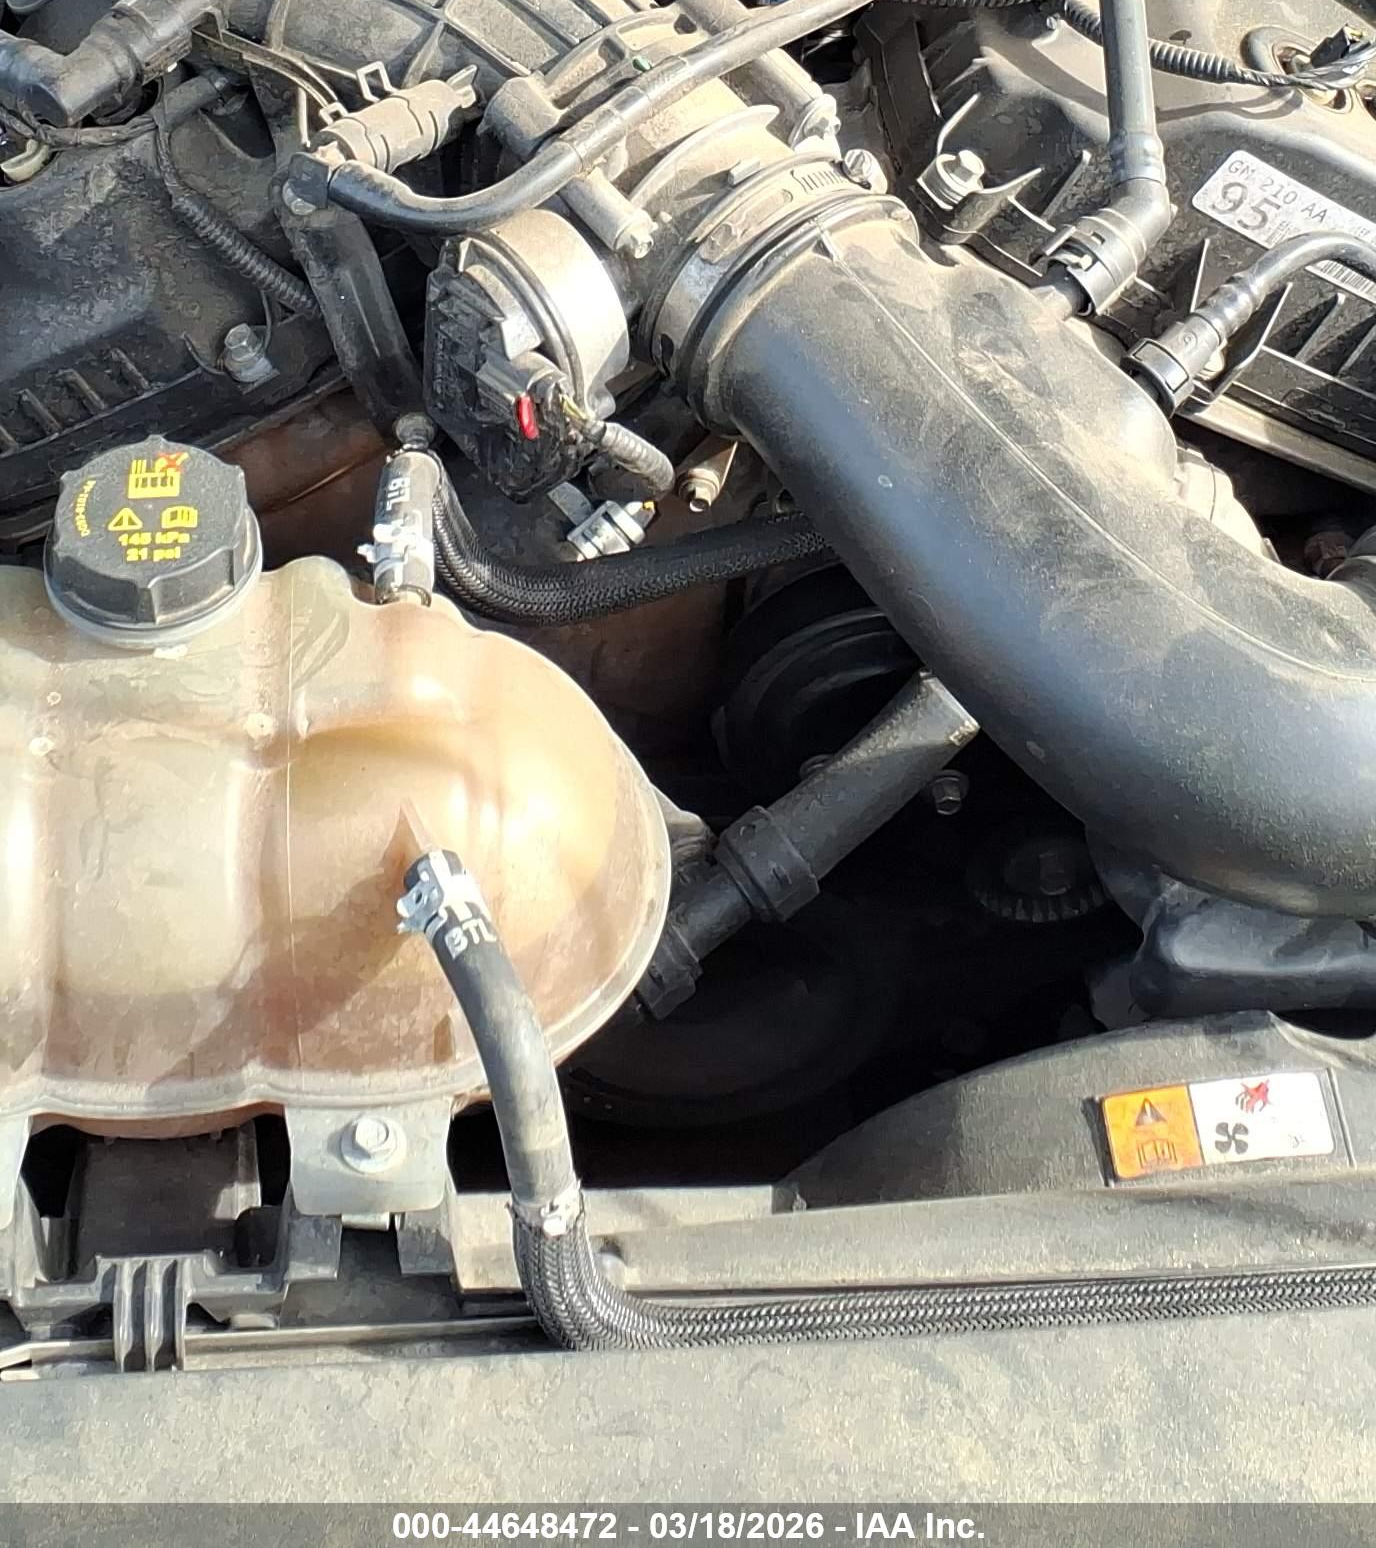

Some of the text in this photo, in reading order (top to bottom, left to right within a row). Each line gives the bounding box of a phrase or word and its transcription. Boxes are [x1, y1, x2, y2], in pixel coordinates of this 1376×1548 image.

[1210, 181, 1282, 231] 95
[1259, 176, 1299, 205] 210
[1300, 202, 1329, 224] AA
[117, 531, 153, 547] 145
[126, 546, 181, 563] 21 psi
